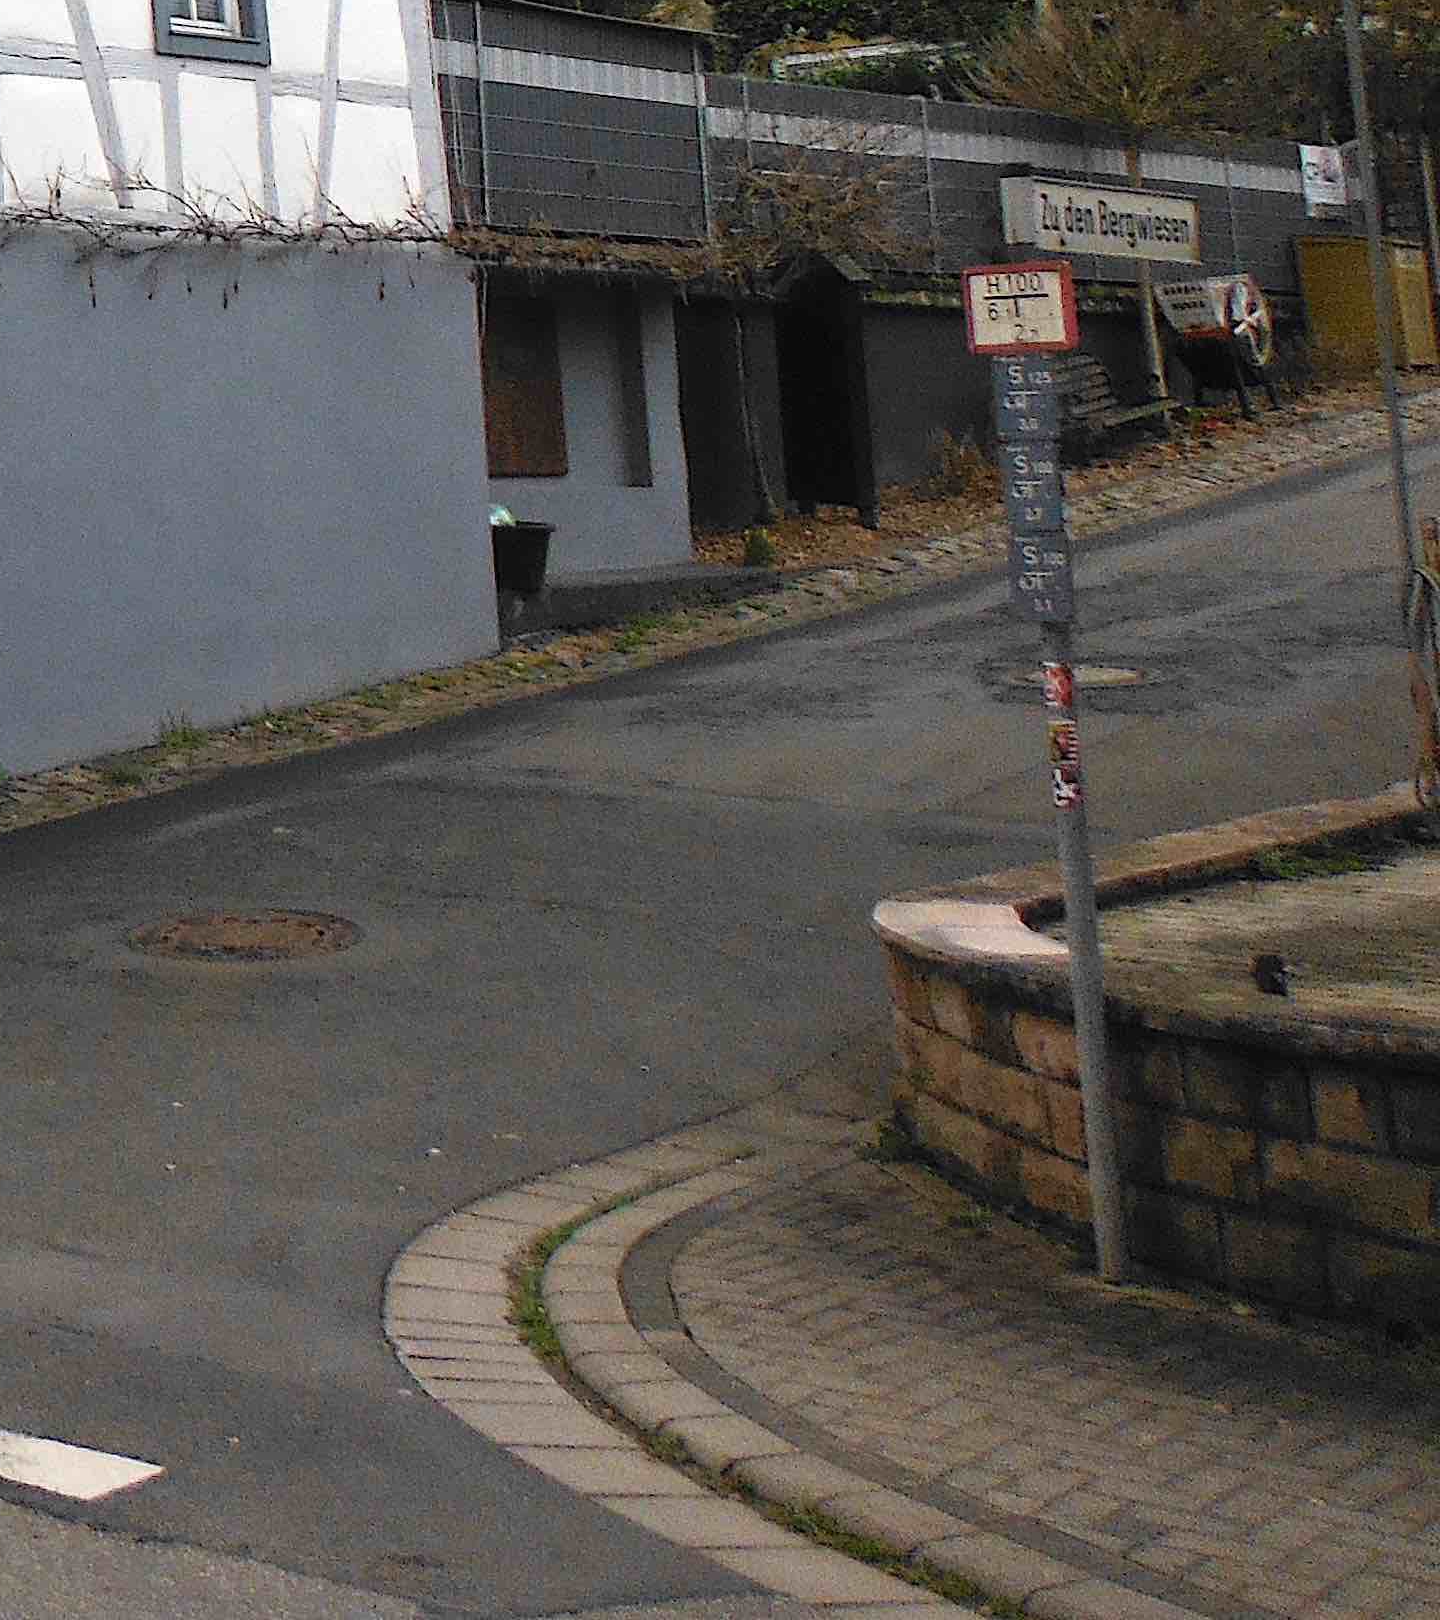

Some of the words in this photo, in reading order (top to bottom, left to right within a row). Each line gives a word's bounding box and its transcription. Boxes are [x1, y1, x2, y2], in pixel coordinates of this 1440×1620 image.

[1040, 192, 1060, 231] Zu
[1064, 196, 1095, 235] den
[1097, 199, 1190, 248] Bergwiesen
